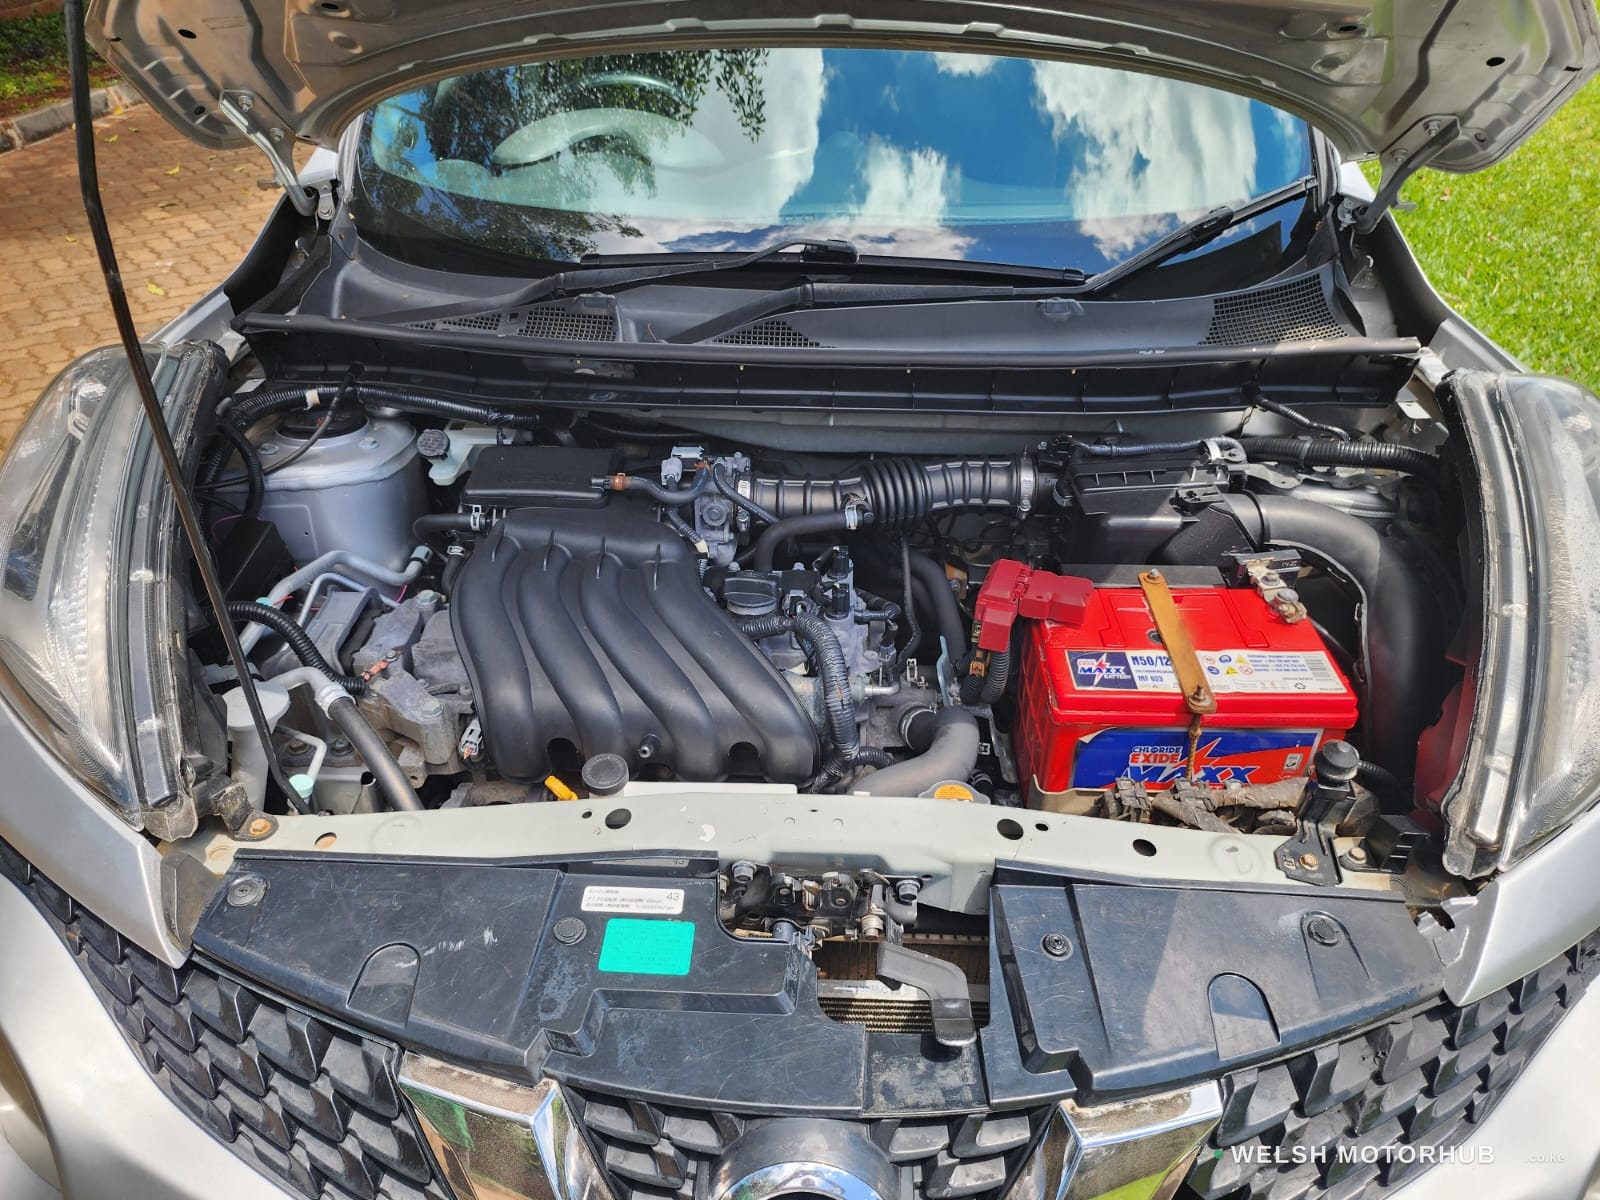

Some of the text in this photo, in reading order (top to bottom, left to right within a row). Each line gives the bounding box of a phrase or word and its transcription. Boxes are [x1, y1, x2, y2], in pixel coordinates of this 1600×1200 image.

[1080, 666, 1125, 674] MAXX
[1132, 746, 1182, 754] CHLORIDE
[1130, 753, 1180, 764] EXIDE
[1122, 765, 1260, 784] MAXX
[666, 892, 680, 902] 43
